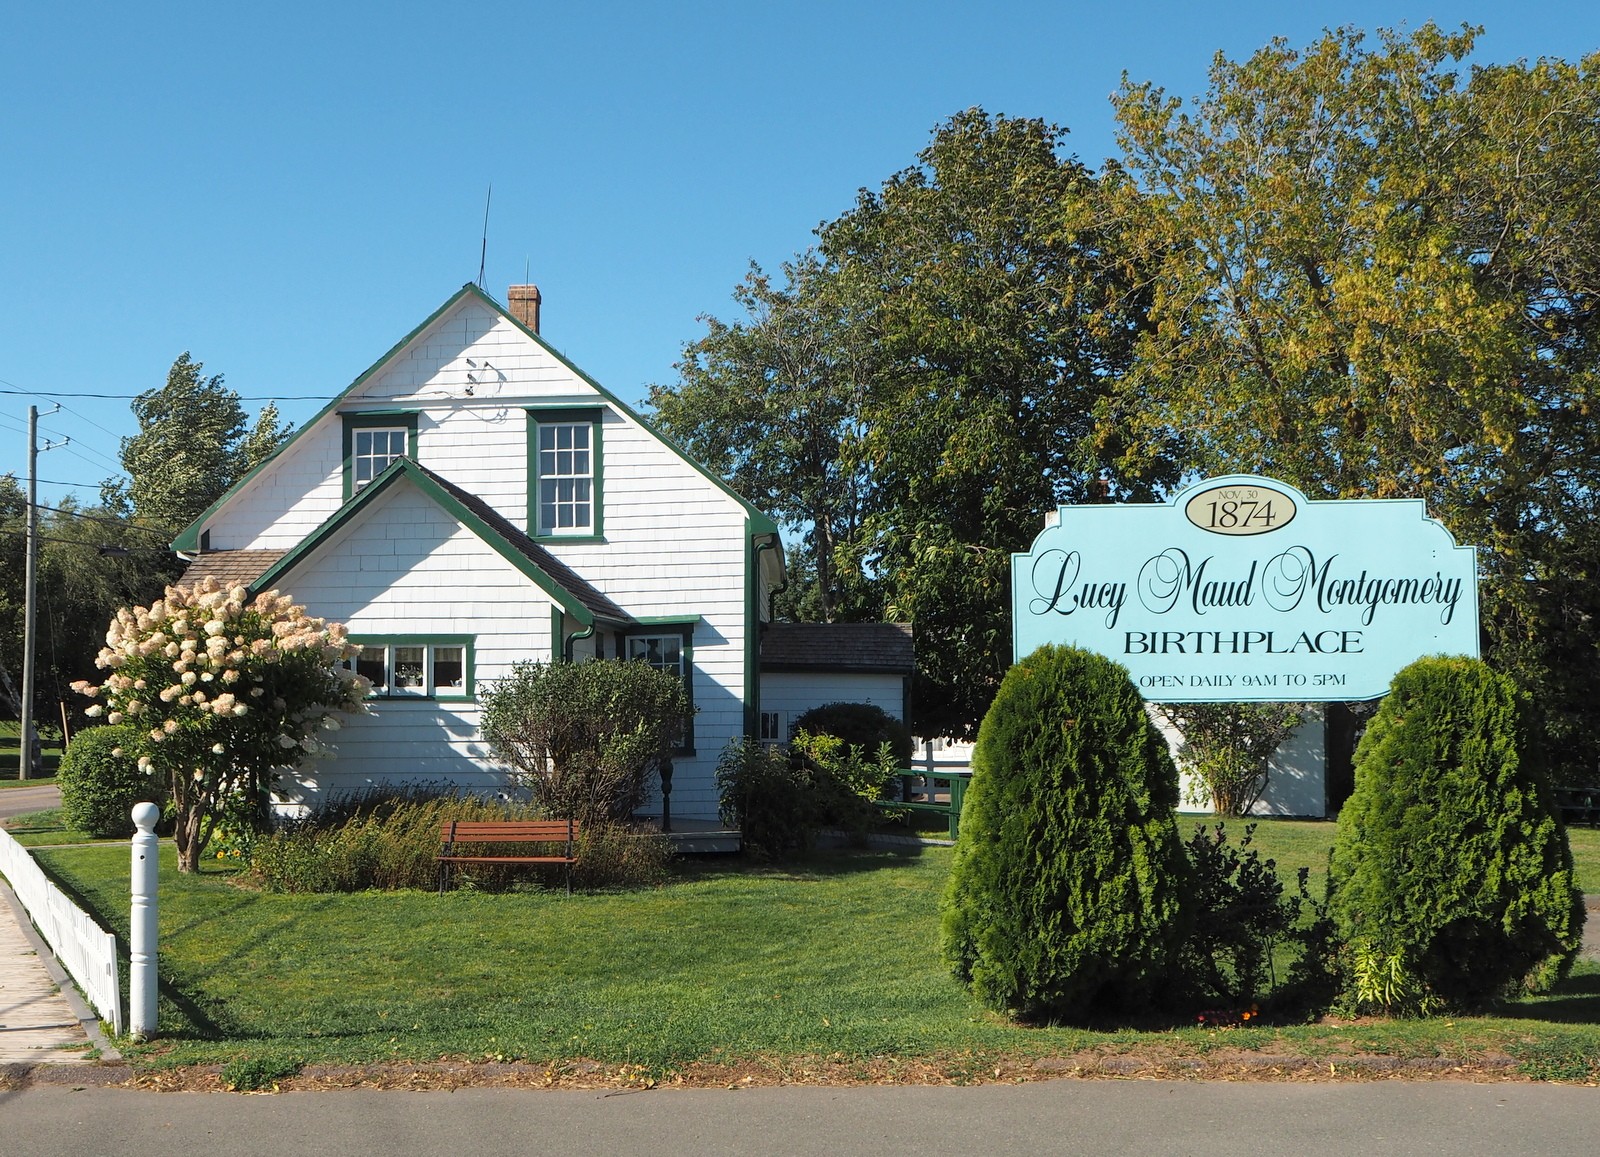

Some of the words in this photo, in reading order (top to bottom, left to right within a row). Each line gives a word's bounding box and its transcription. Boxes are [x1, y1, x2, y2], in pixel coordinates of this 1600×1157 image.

[1247, 490, 1258, 499] 30
[1205, 500, 1276, 528] 1874
[1029, 548, 1127, 629] Lucy
[1137, 547, 1258, 615] Maud
[1262, 545, 1463, 625] Montgomery
[1124, 630, 1364, 654] BIRTHPLACE
[1140, 675, 1185, 688] OPEN
[1190, 675, 1237, 687] DAILY
[1242, 675, 1277, 687] 9AM
[1283, 674, 1306, 686] TO
[1312, 674, 1346, 686] 5PM
